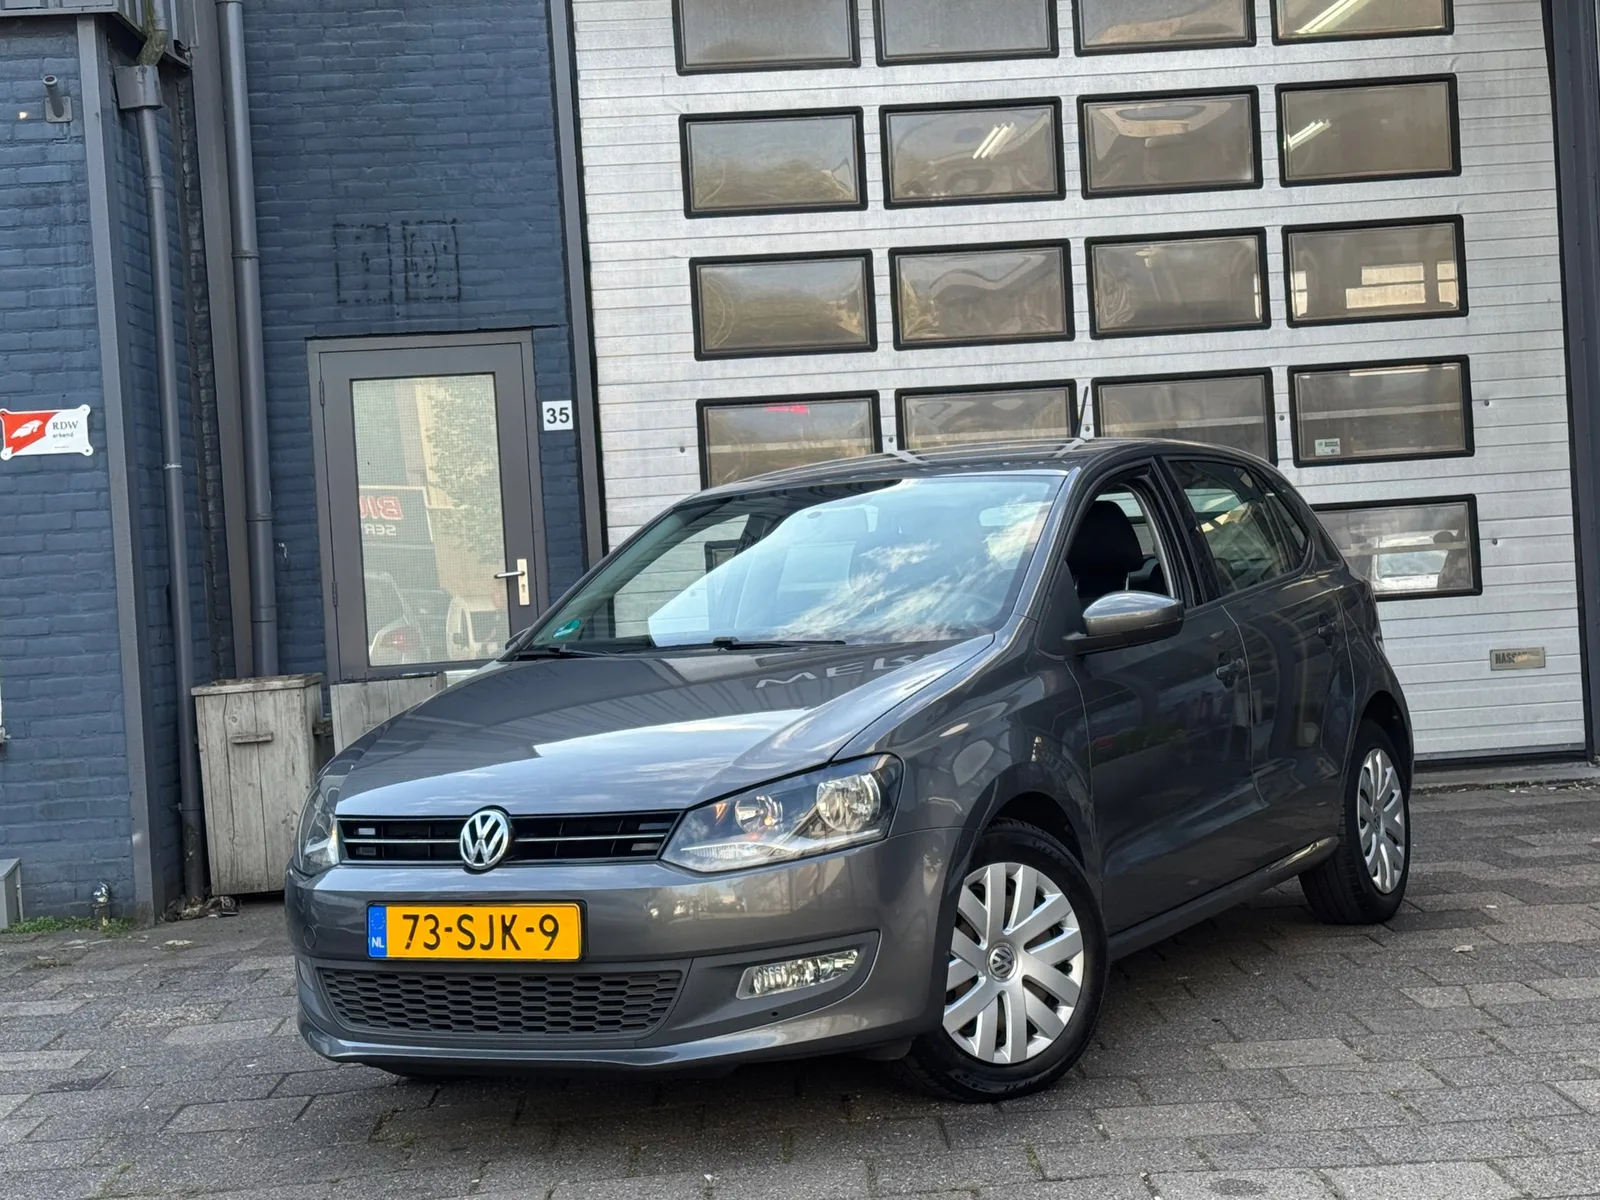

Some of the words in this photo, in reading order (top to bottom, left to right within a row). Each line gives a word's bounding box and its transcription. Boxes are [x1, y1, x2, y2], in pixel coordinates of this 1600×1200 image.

[546, 407, 570, 424] 35
[52, 420, 79, 430] RDW
[402, 914, 559, 951] 73-SJK-9
[371, 937, 385, 948] NL
